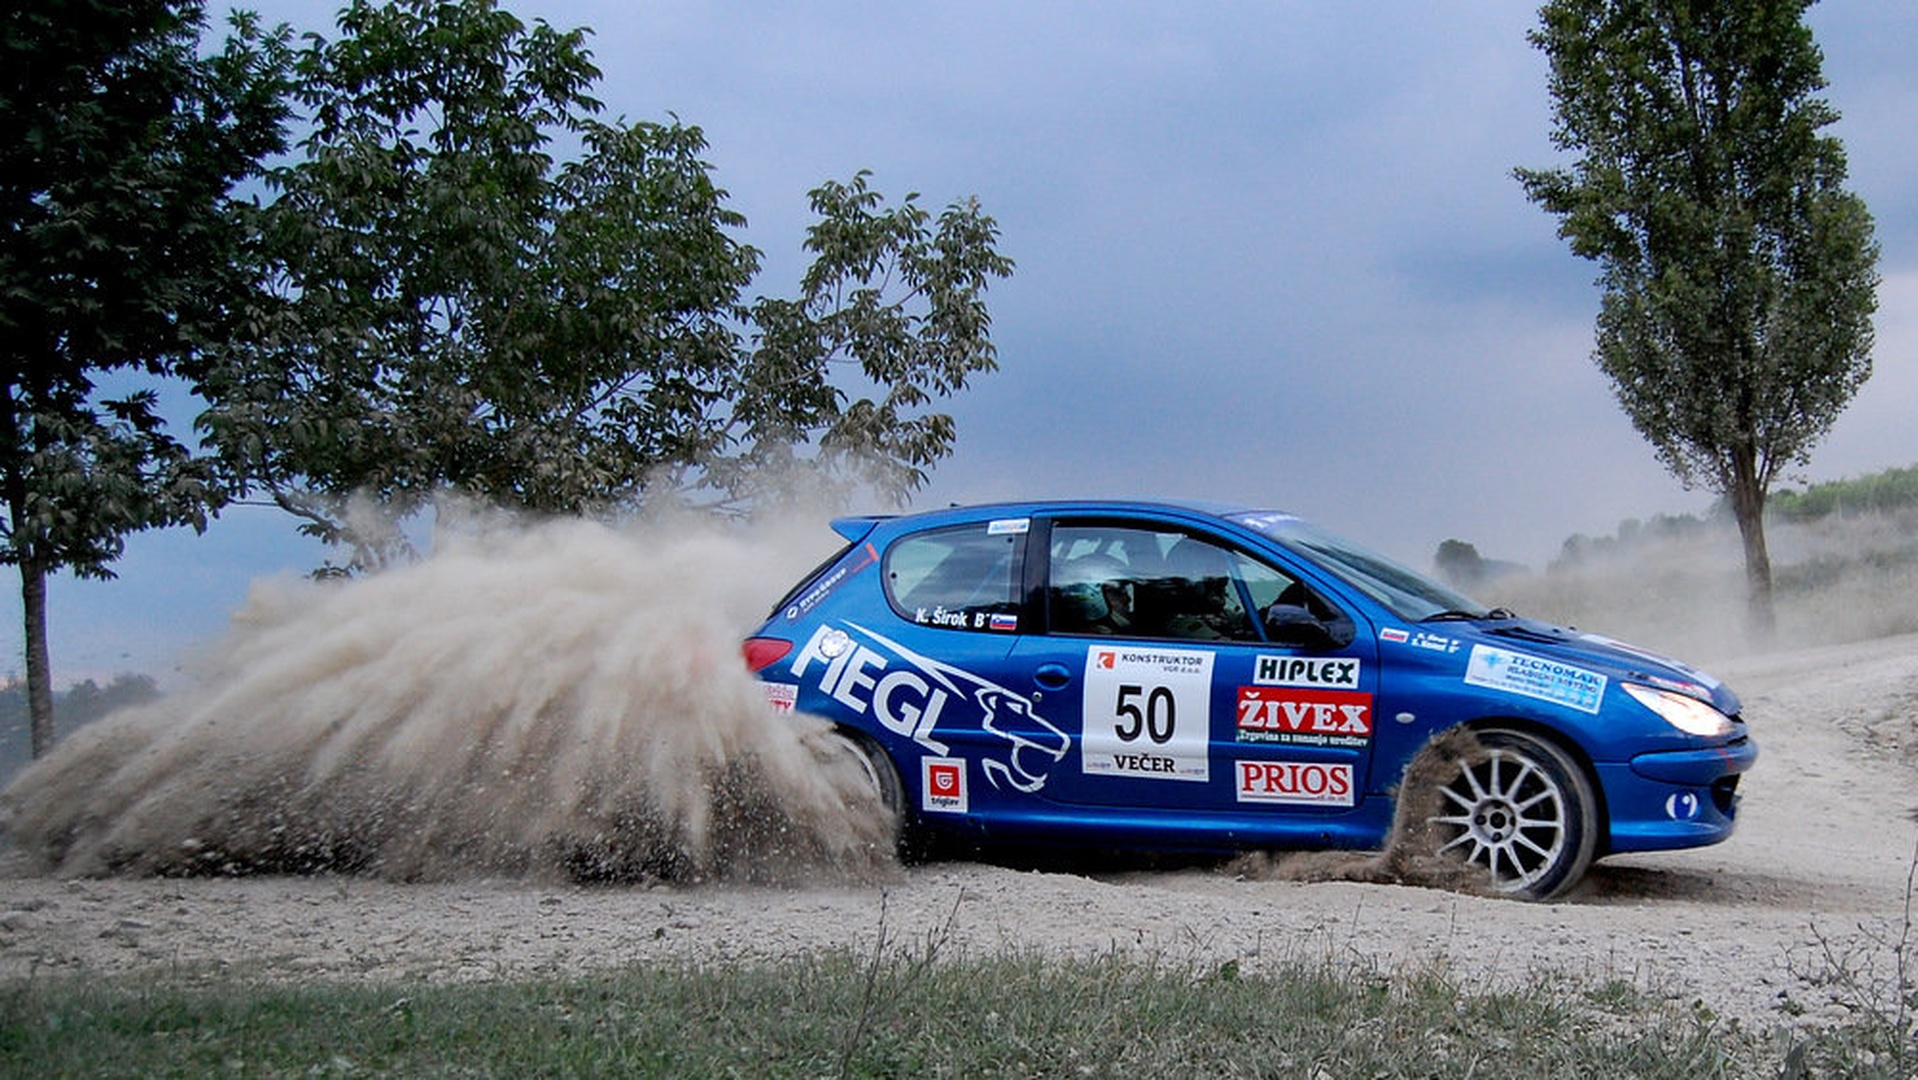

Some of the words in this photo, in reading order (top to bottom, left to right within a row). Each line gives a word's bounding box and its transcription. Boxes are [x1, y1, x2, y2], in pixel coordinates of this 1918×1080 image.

[932, 605, 968, 628] Širok
[1121, 653, 1204, 666] KONSTRUKTOR
[1259, 658, 1355, 684] HIPLEX
[1114, 684, 1177, 745] 50
[1239, 691, 1369, 733] ŽIVEX
[1113, 752, 1176, 774] VEČER
[1240, 762, 1349, 796] PRIOS
